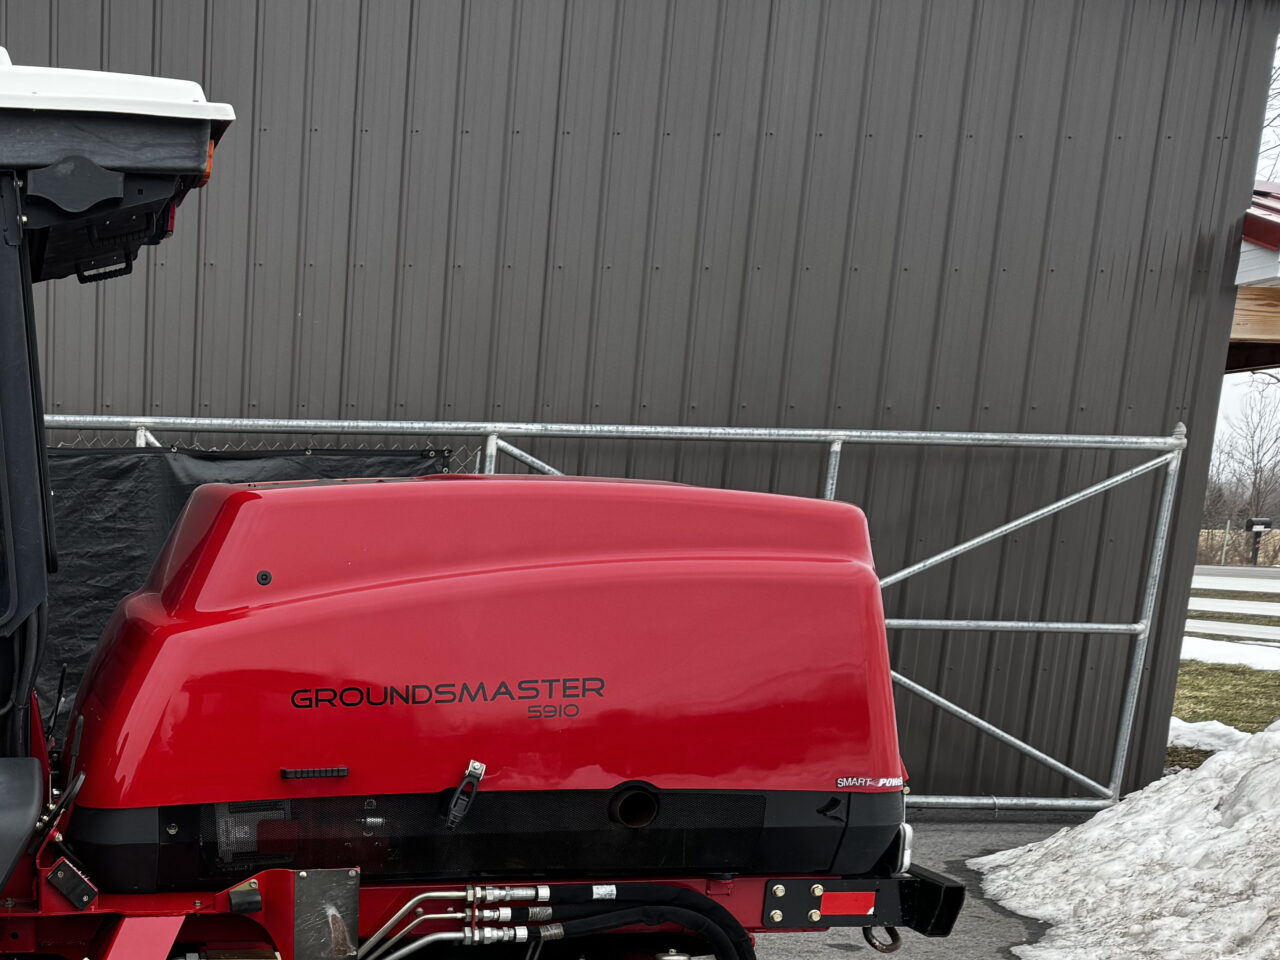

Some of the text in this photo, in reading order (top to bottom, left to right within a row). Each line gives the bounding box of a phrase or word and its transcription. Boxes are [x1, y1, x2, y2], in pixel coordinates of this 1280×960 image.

[290, 677, 606, 709] GROUNDSMASTER
[527, 703, 580, 719] 5910
[837, 778, 872, 788] SMART
